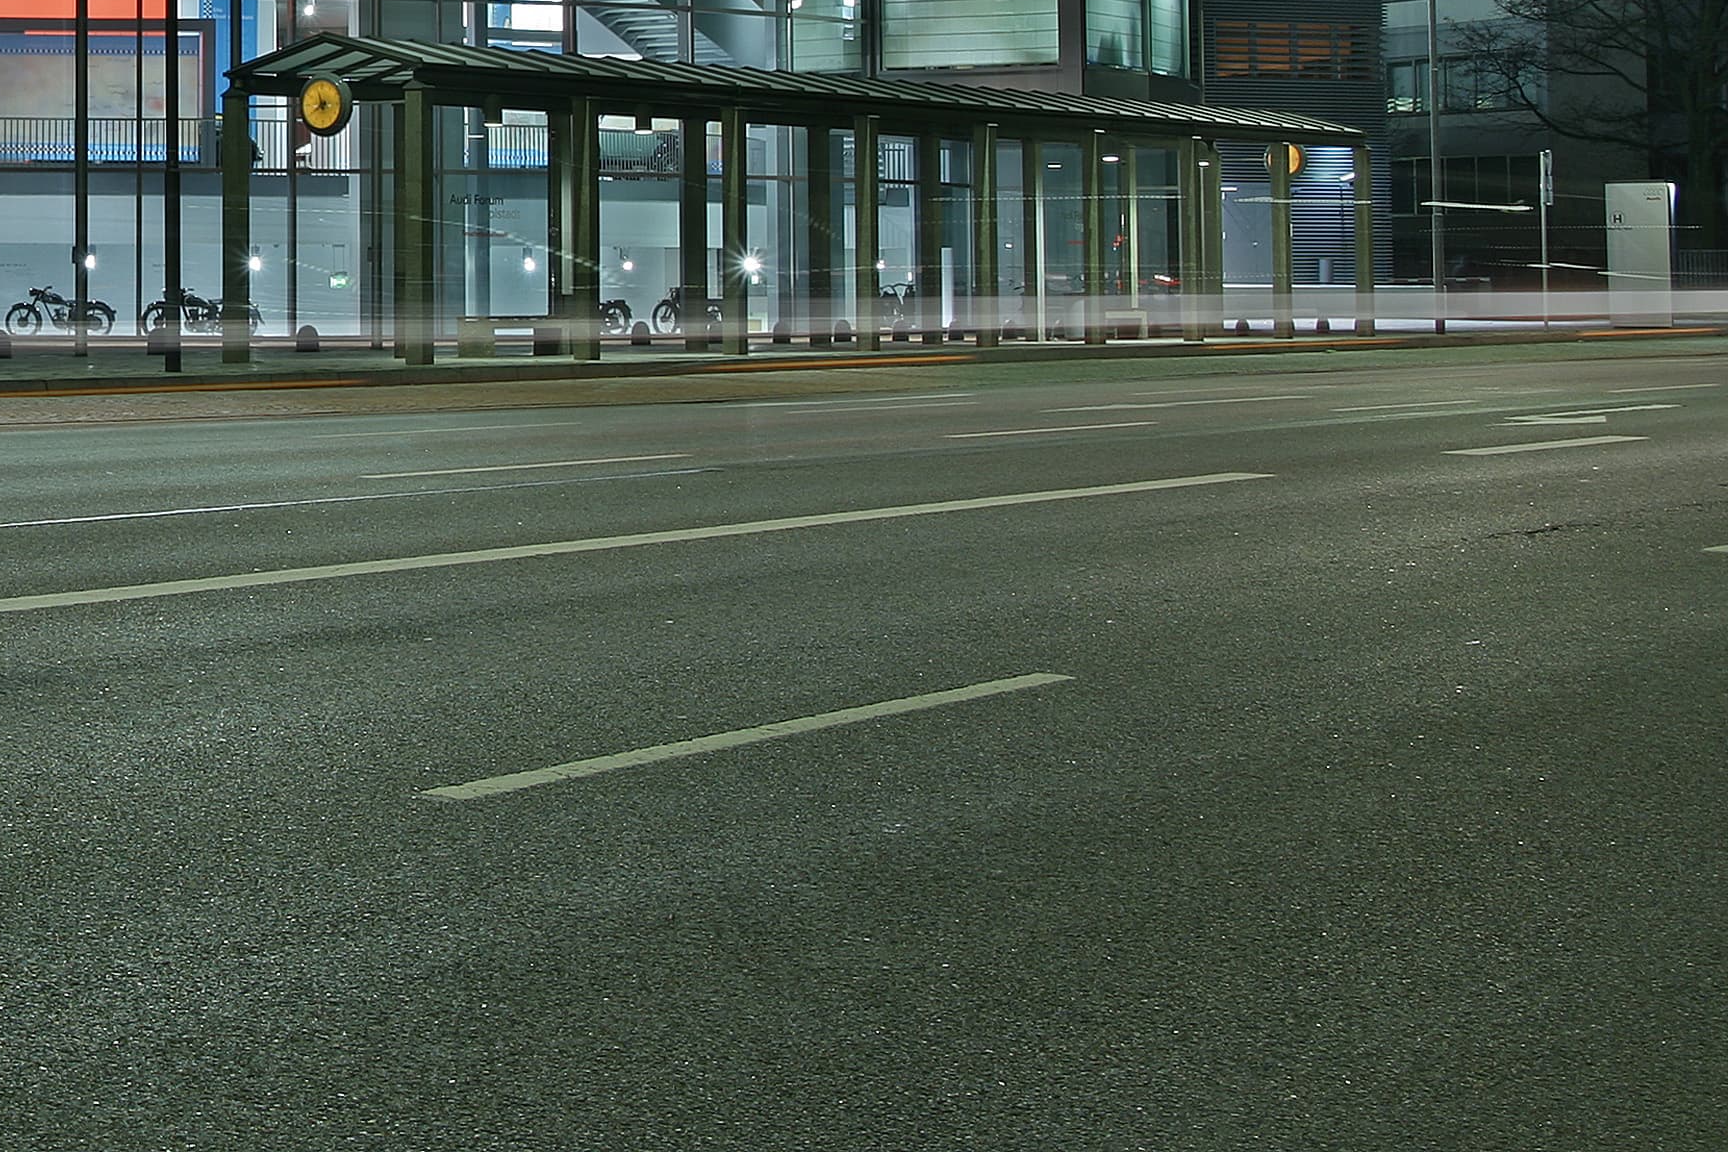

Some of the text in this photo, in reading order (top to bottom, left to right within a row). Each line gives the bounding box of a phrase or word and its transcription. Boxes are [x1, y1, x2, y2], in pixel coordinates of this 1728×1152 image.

[450, 194, 504, 205] Audi Forum
[1613, 214, 1622, 224] H
